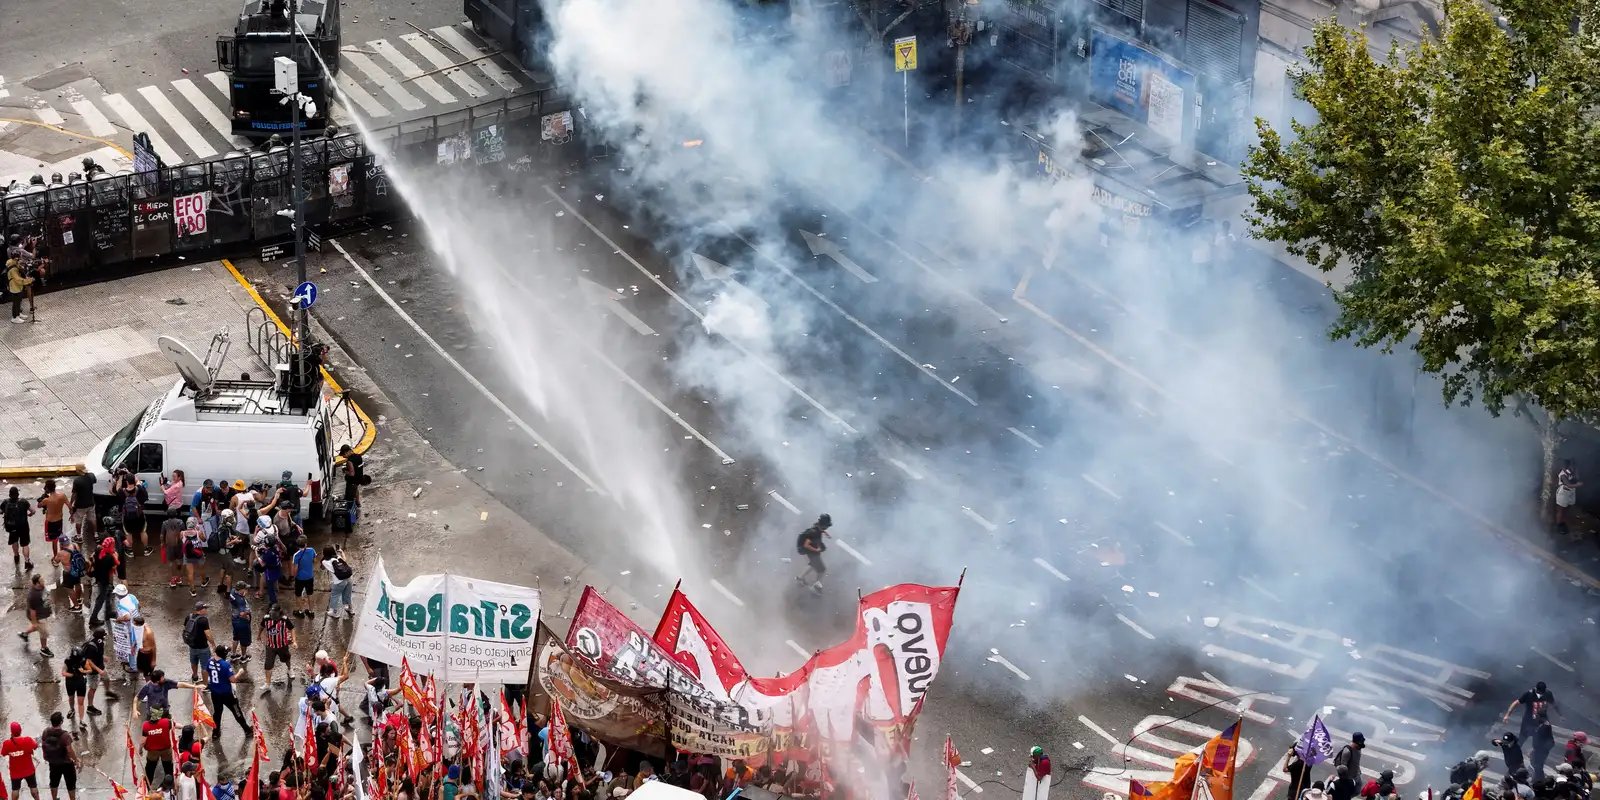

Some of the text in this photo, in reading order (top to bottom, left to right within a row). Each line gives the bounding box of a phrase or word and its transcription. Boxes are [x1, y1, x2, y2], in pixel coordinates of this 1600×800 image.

[133, 202, 169, 211] EL MIEDO
[176, 195, 203, 217] EFO
[134, 214, 144, 223] EL
[178, 213, 206, 236] ABO
[211, 670, 219, 684] 8
